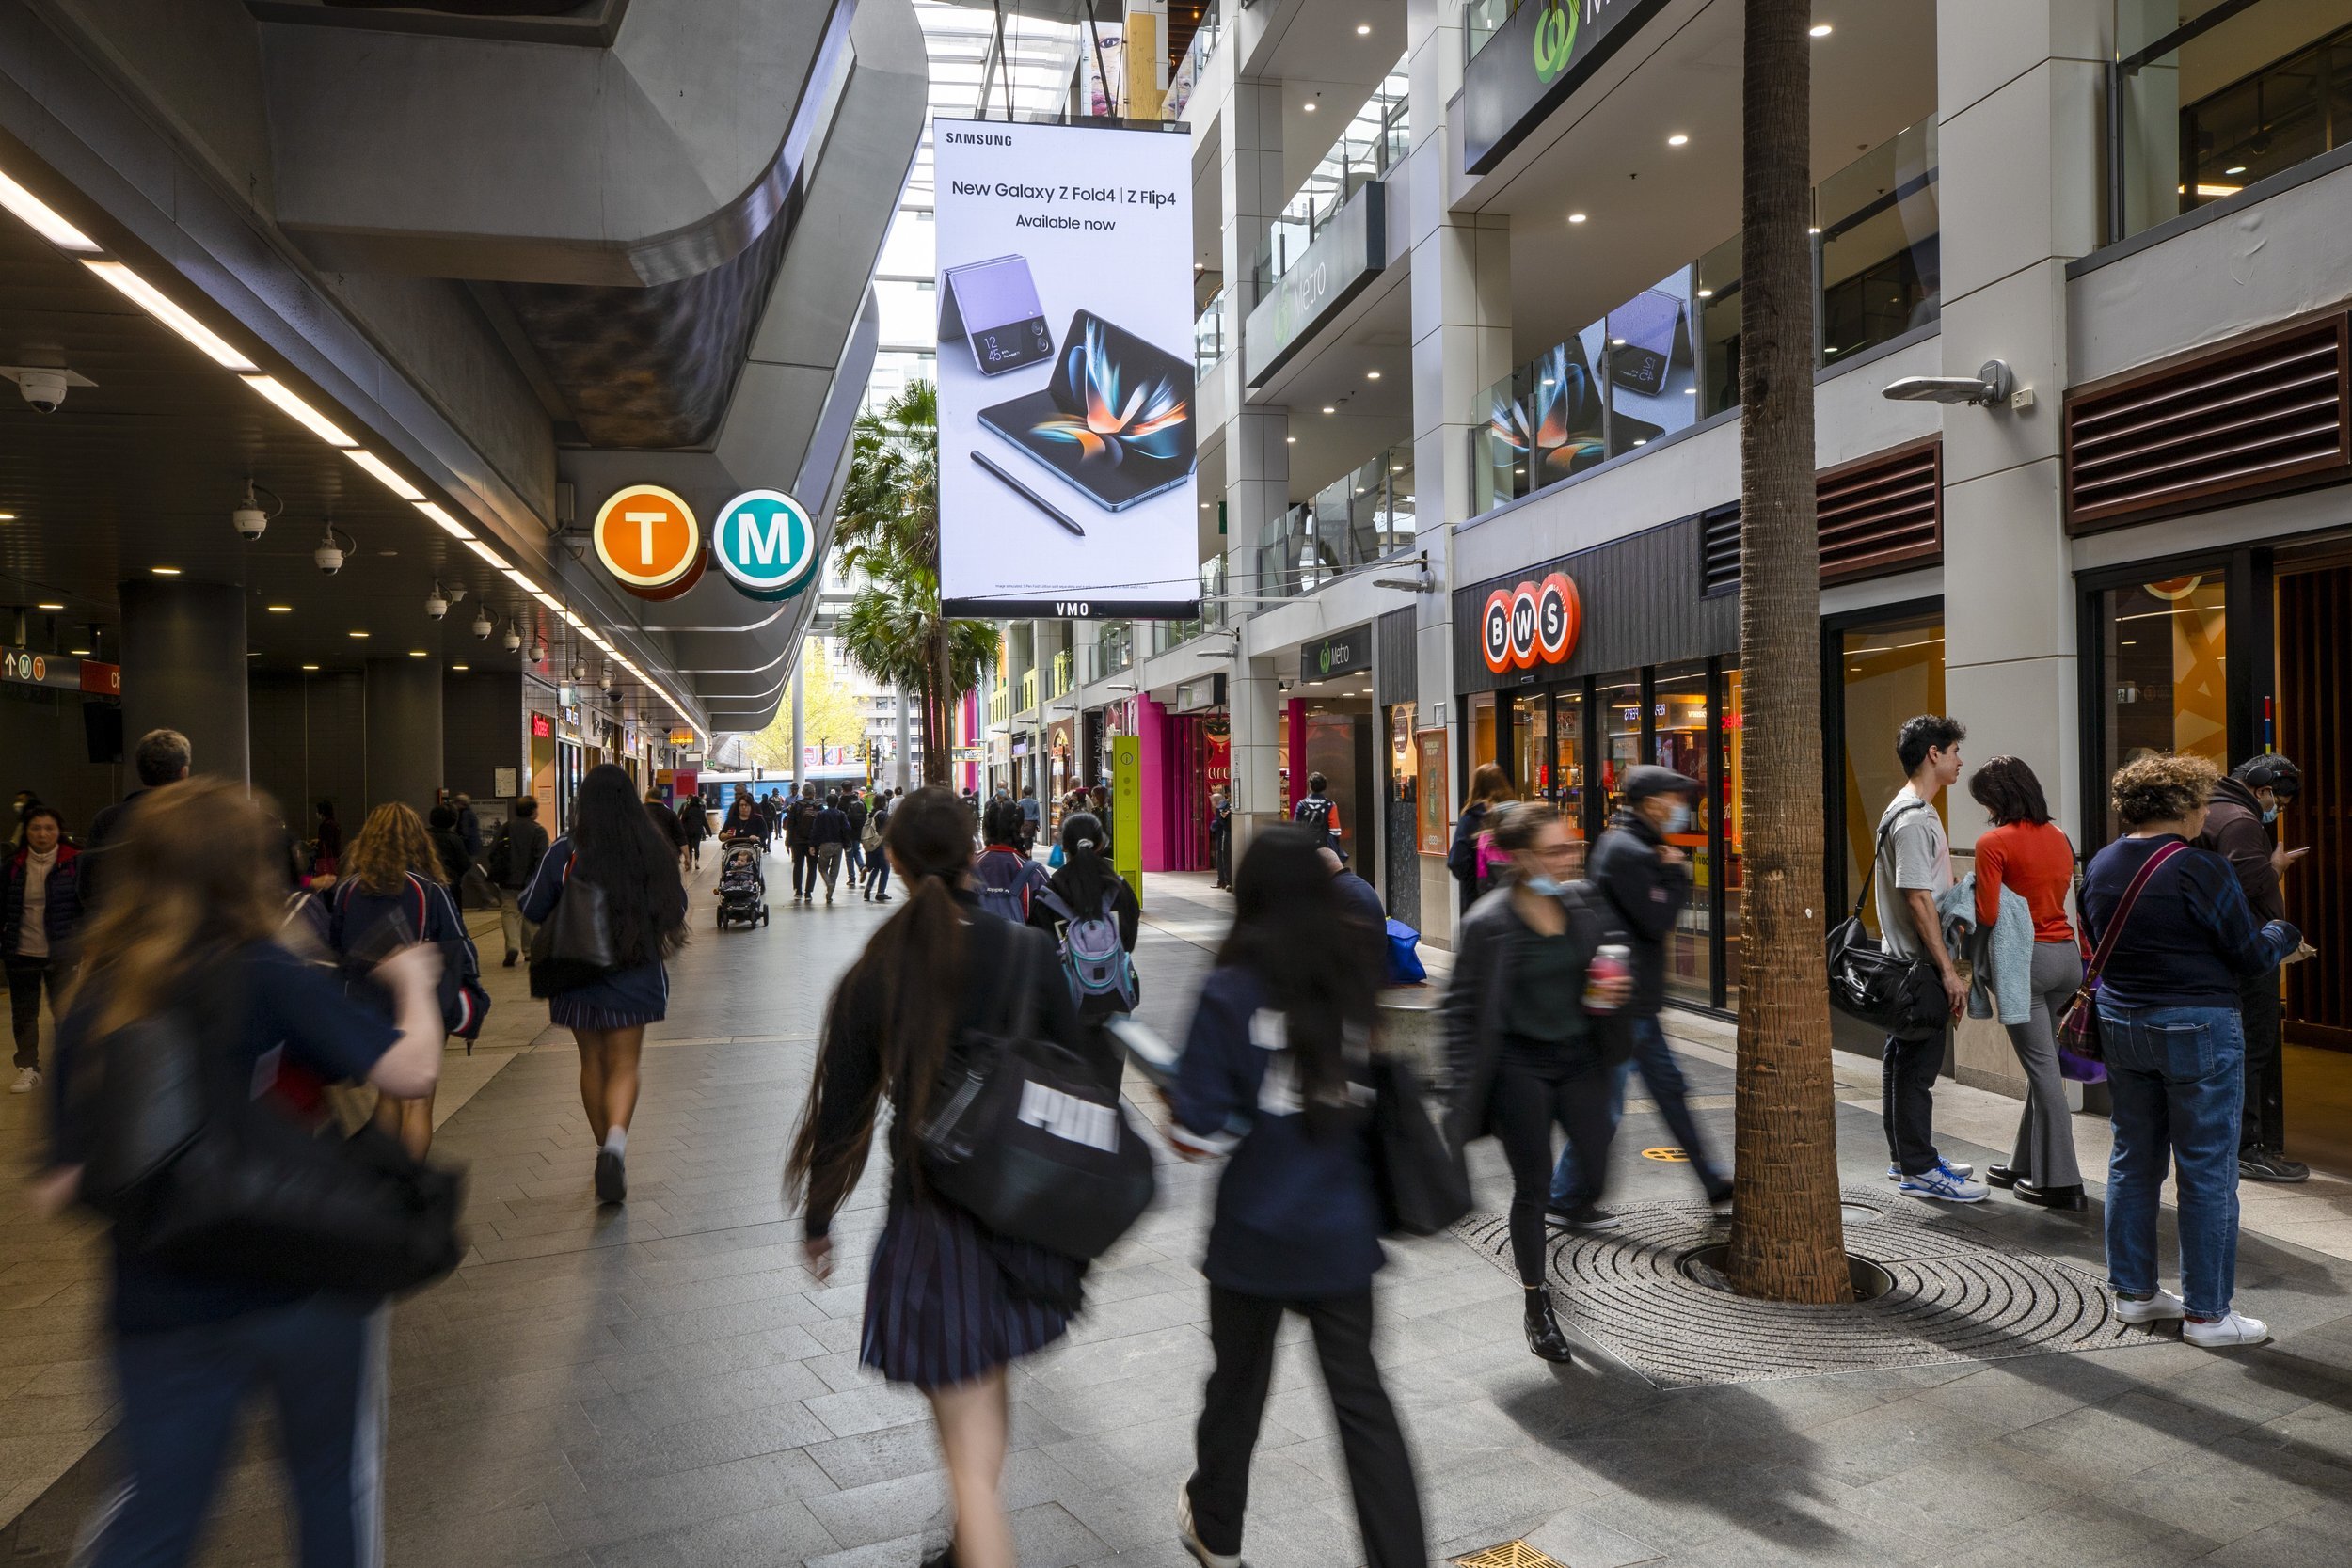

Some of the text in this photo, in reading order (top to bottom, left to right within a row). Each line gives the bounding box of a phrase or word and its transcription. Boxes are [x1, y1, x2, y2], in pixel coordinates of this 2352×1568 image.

[946, 132, 1012, 147] SAMSUNG
[952, 181, 1177, 209] New Galaxy Z Fold4 Z Flip4
[1016, 214, 1116, 231] Available now
[1294, 261, 1327, 321] Metro
[984, 336, 998, 350] 12
[988, 349, 1002, 362] 45
[625, 512, 791, 565] T M
[1056, 602, 1089, 616] VMO
[1492, 603, 1559, 647] BWS
[1331, 643, 1350, 666] Metro
[21, 659, 42, 676] M T
